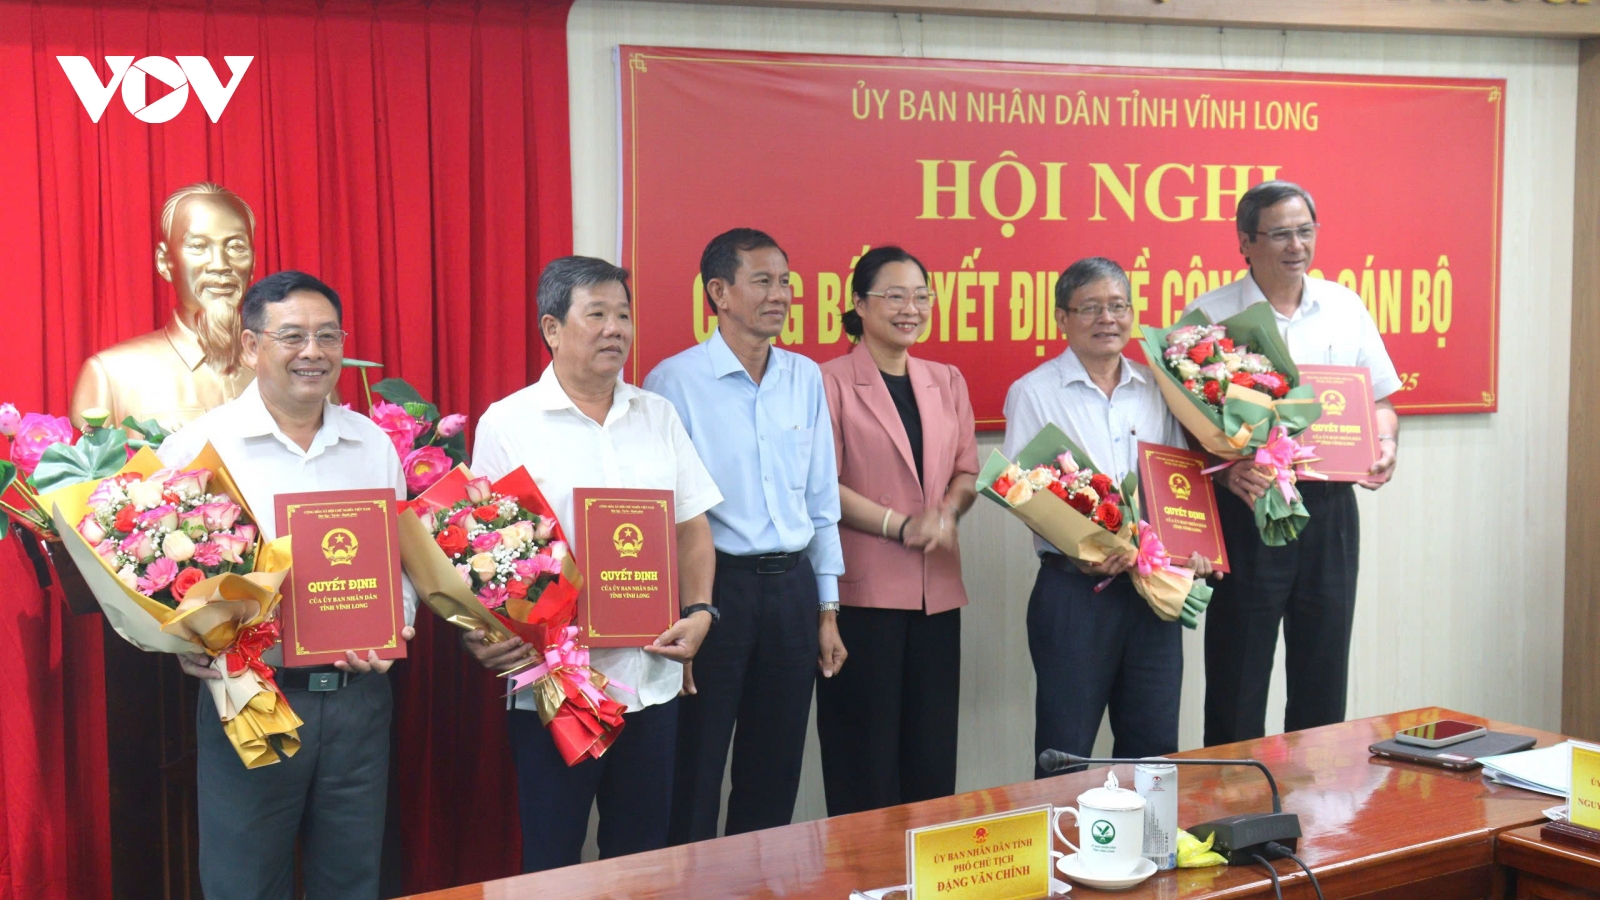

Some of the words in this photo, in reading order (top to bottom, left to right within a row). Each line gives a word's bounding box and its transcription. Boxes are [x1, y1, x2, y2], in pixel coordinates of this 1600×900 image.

[853, 81, 889, 119] ỦY
[899, 90, 957, 121] BAN
[967, 87, 1046, 124] NHÂN
[1056, 90, 1109, 126] DÂN
[1116, 89, 1177, 127] TỈNH
[1184, 93, 1245, 129] VĨNH
[1255, 101, 1318, 131] LONG
[915, 150, 1068, 238] HỘI
[693, 271, 804, 345] CG
[916, 248, 1000, 343] YẾT
[1124, 247, 1150, 338] Ề
[1162, 255, 1248, 329] CÔ
[1337, 255, 1402, 334] ÁN
[1411, 255, 1453, 348] BỘ
[308, 577, 346, 593] QUYẾT
[348, 578, 377, 591] ĐỊNH
[600, 567, 632, 581] QUYẾT
[634, 571, 658, 583] ĐỊNH
[934, 853, 945, 863] ỦY
[948, 851, 965, 861] BAN
[967, 846, 990, 857] NHÂN
[993, 842, 1010, 853] DÂN
[1013, 838, 1032, 849] TỈNH
[954, 861, 971, 873] PHÓ
[973, 857, 991, 869] CHỦ
[993, 855, 1014, 866] TỊCH
[937, 877, 968, 892] ĐẶNG
[971, 872, 993, 885] VĂN
[995, 865, 1030, 880] CHÍNH
